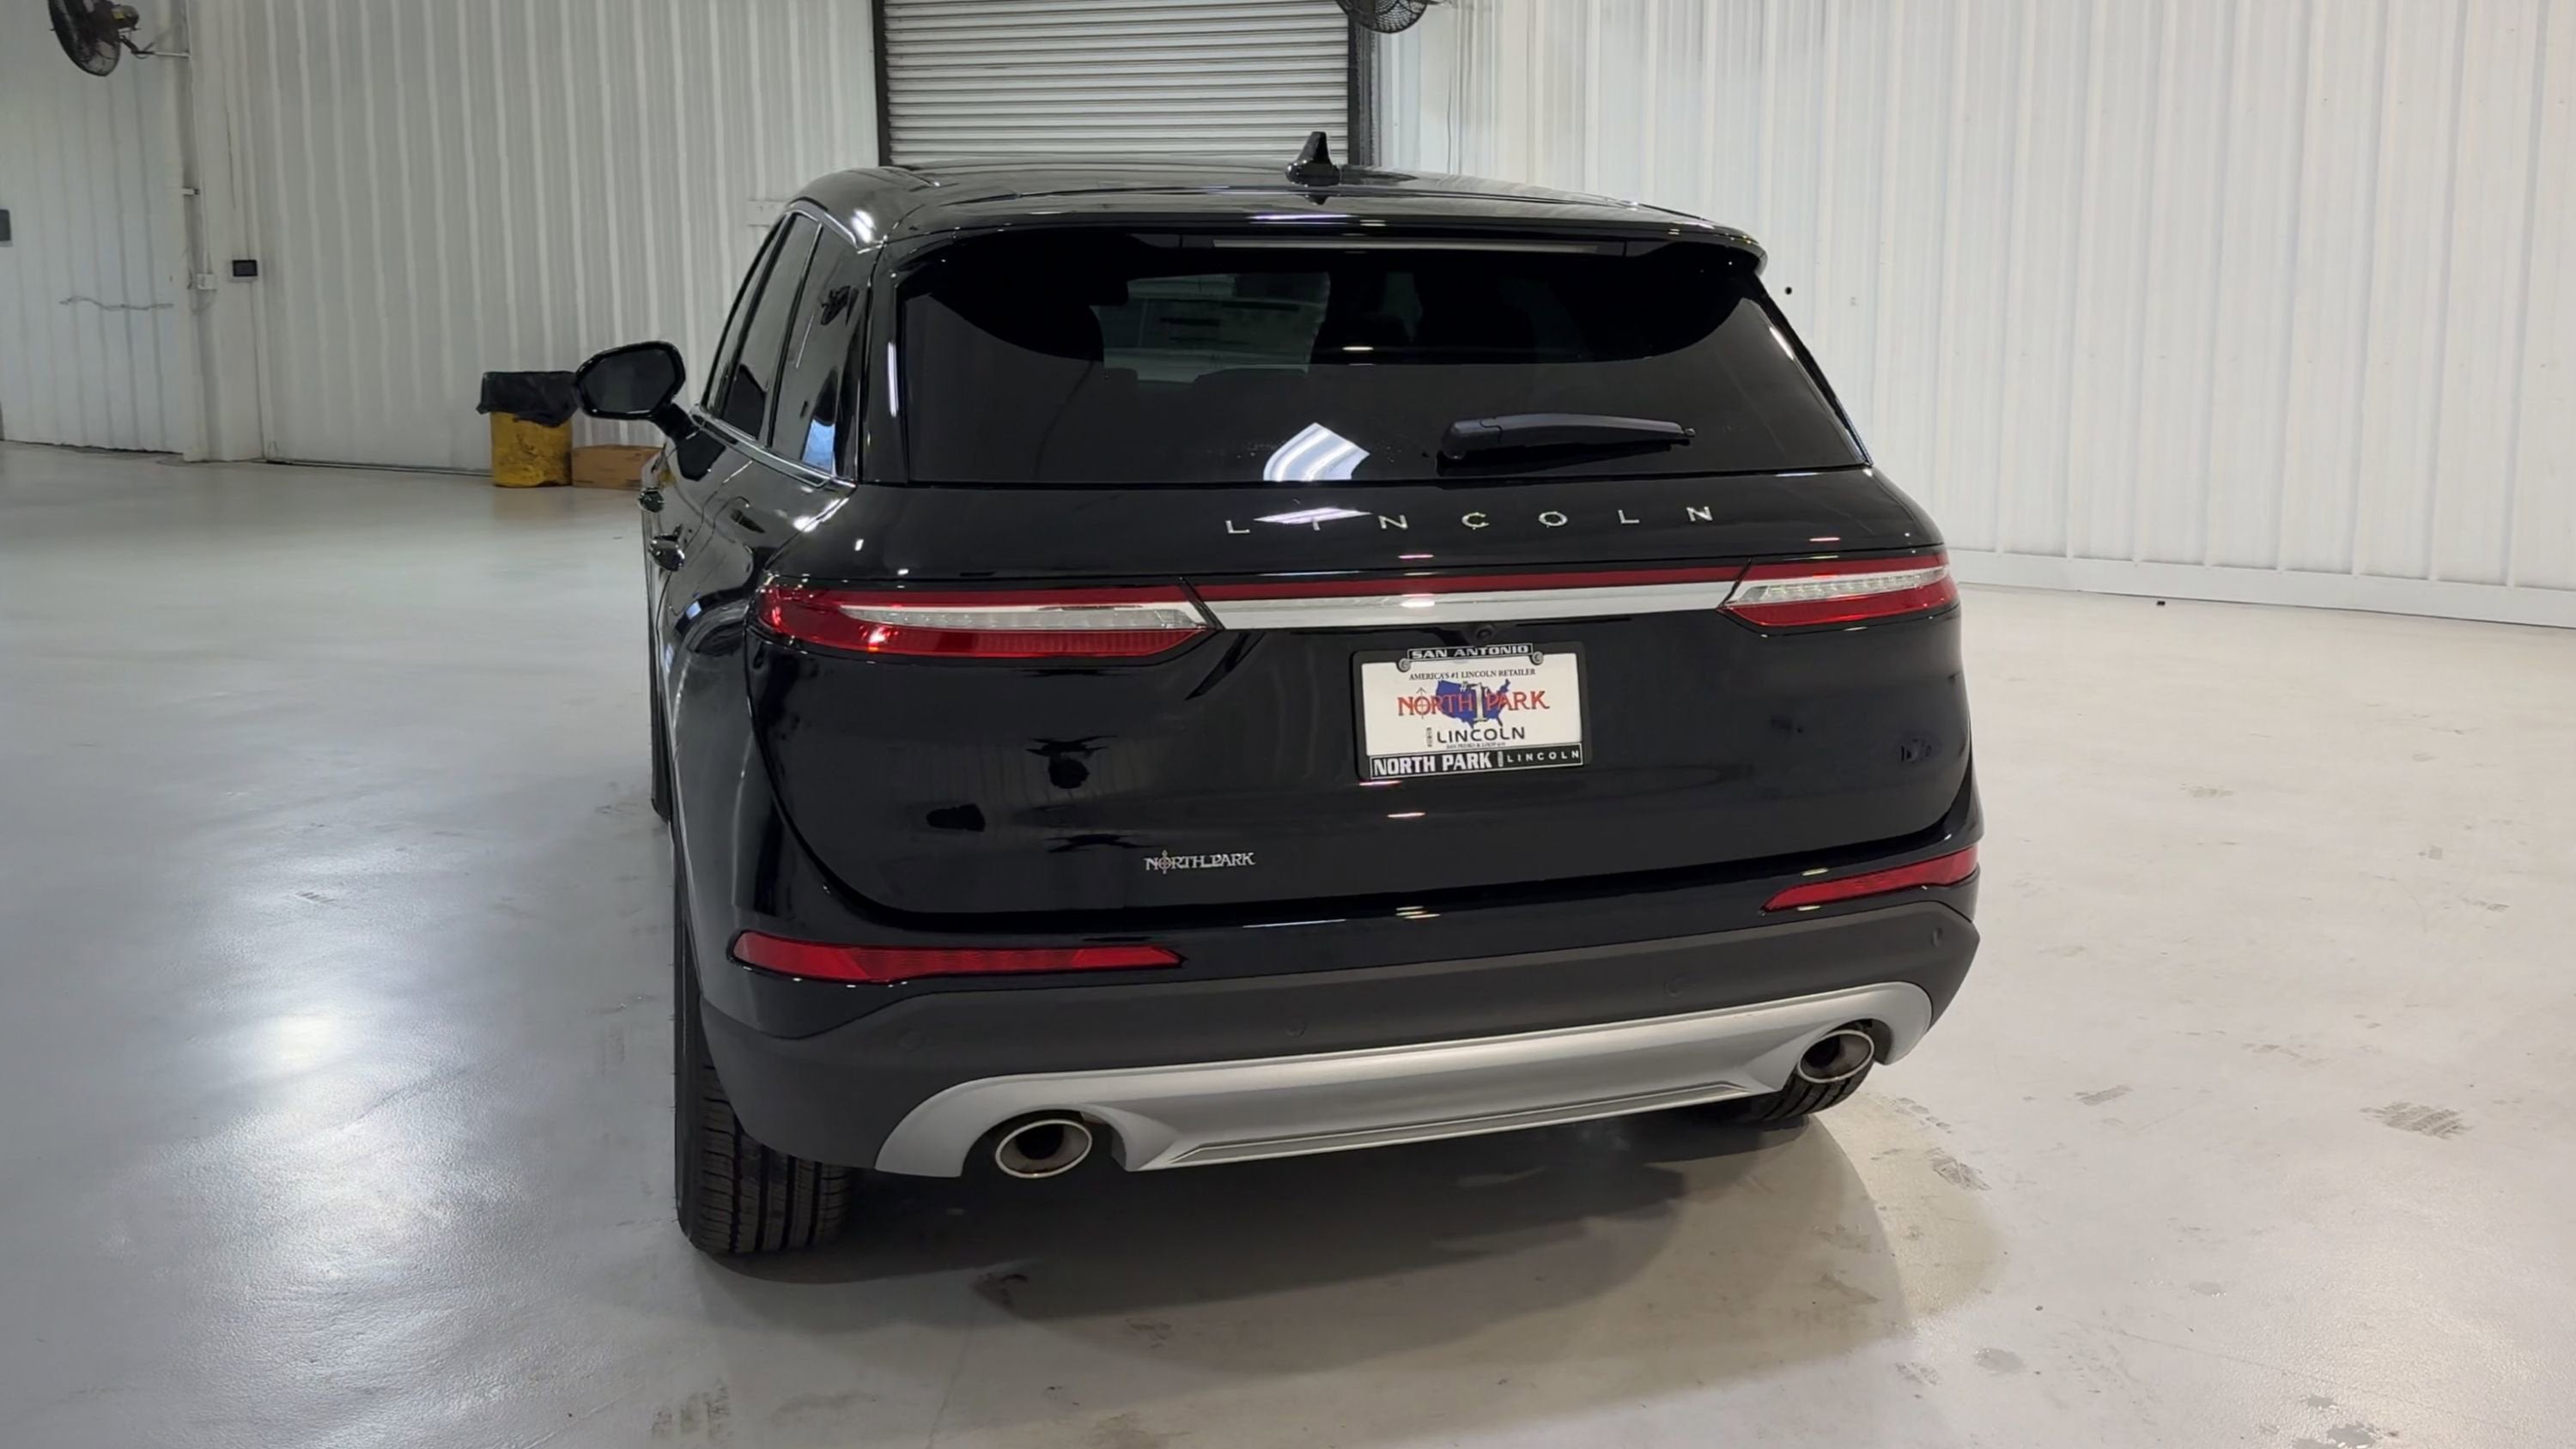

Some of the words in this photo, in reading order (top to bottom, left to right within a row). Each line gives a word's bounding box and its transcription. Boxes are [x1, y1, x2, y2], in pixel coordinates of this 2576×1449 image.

[1225, 506, 1712, 534] LINCOLN
[1412, 649, 1448, 659] SAN
[1454, 645, 1529, 658] ANTONIO
[1409, 671, 1449, 681] AMERICA'S
[1461, 670, 1498, 678] LINCOLN
[1498, 668, 1536, 676] RETAILER
[1397, 693, 1473, 717] NORTH
[1486, 690, 1551, 712] PARK
[1437, 726, 1525, 743] LINCOLN
[1374, 755, 1436, 776] NORTH
[1442, 751, 1492, 771] PARK
[1506, 749, 1580, 763] LINCOLN
